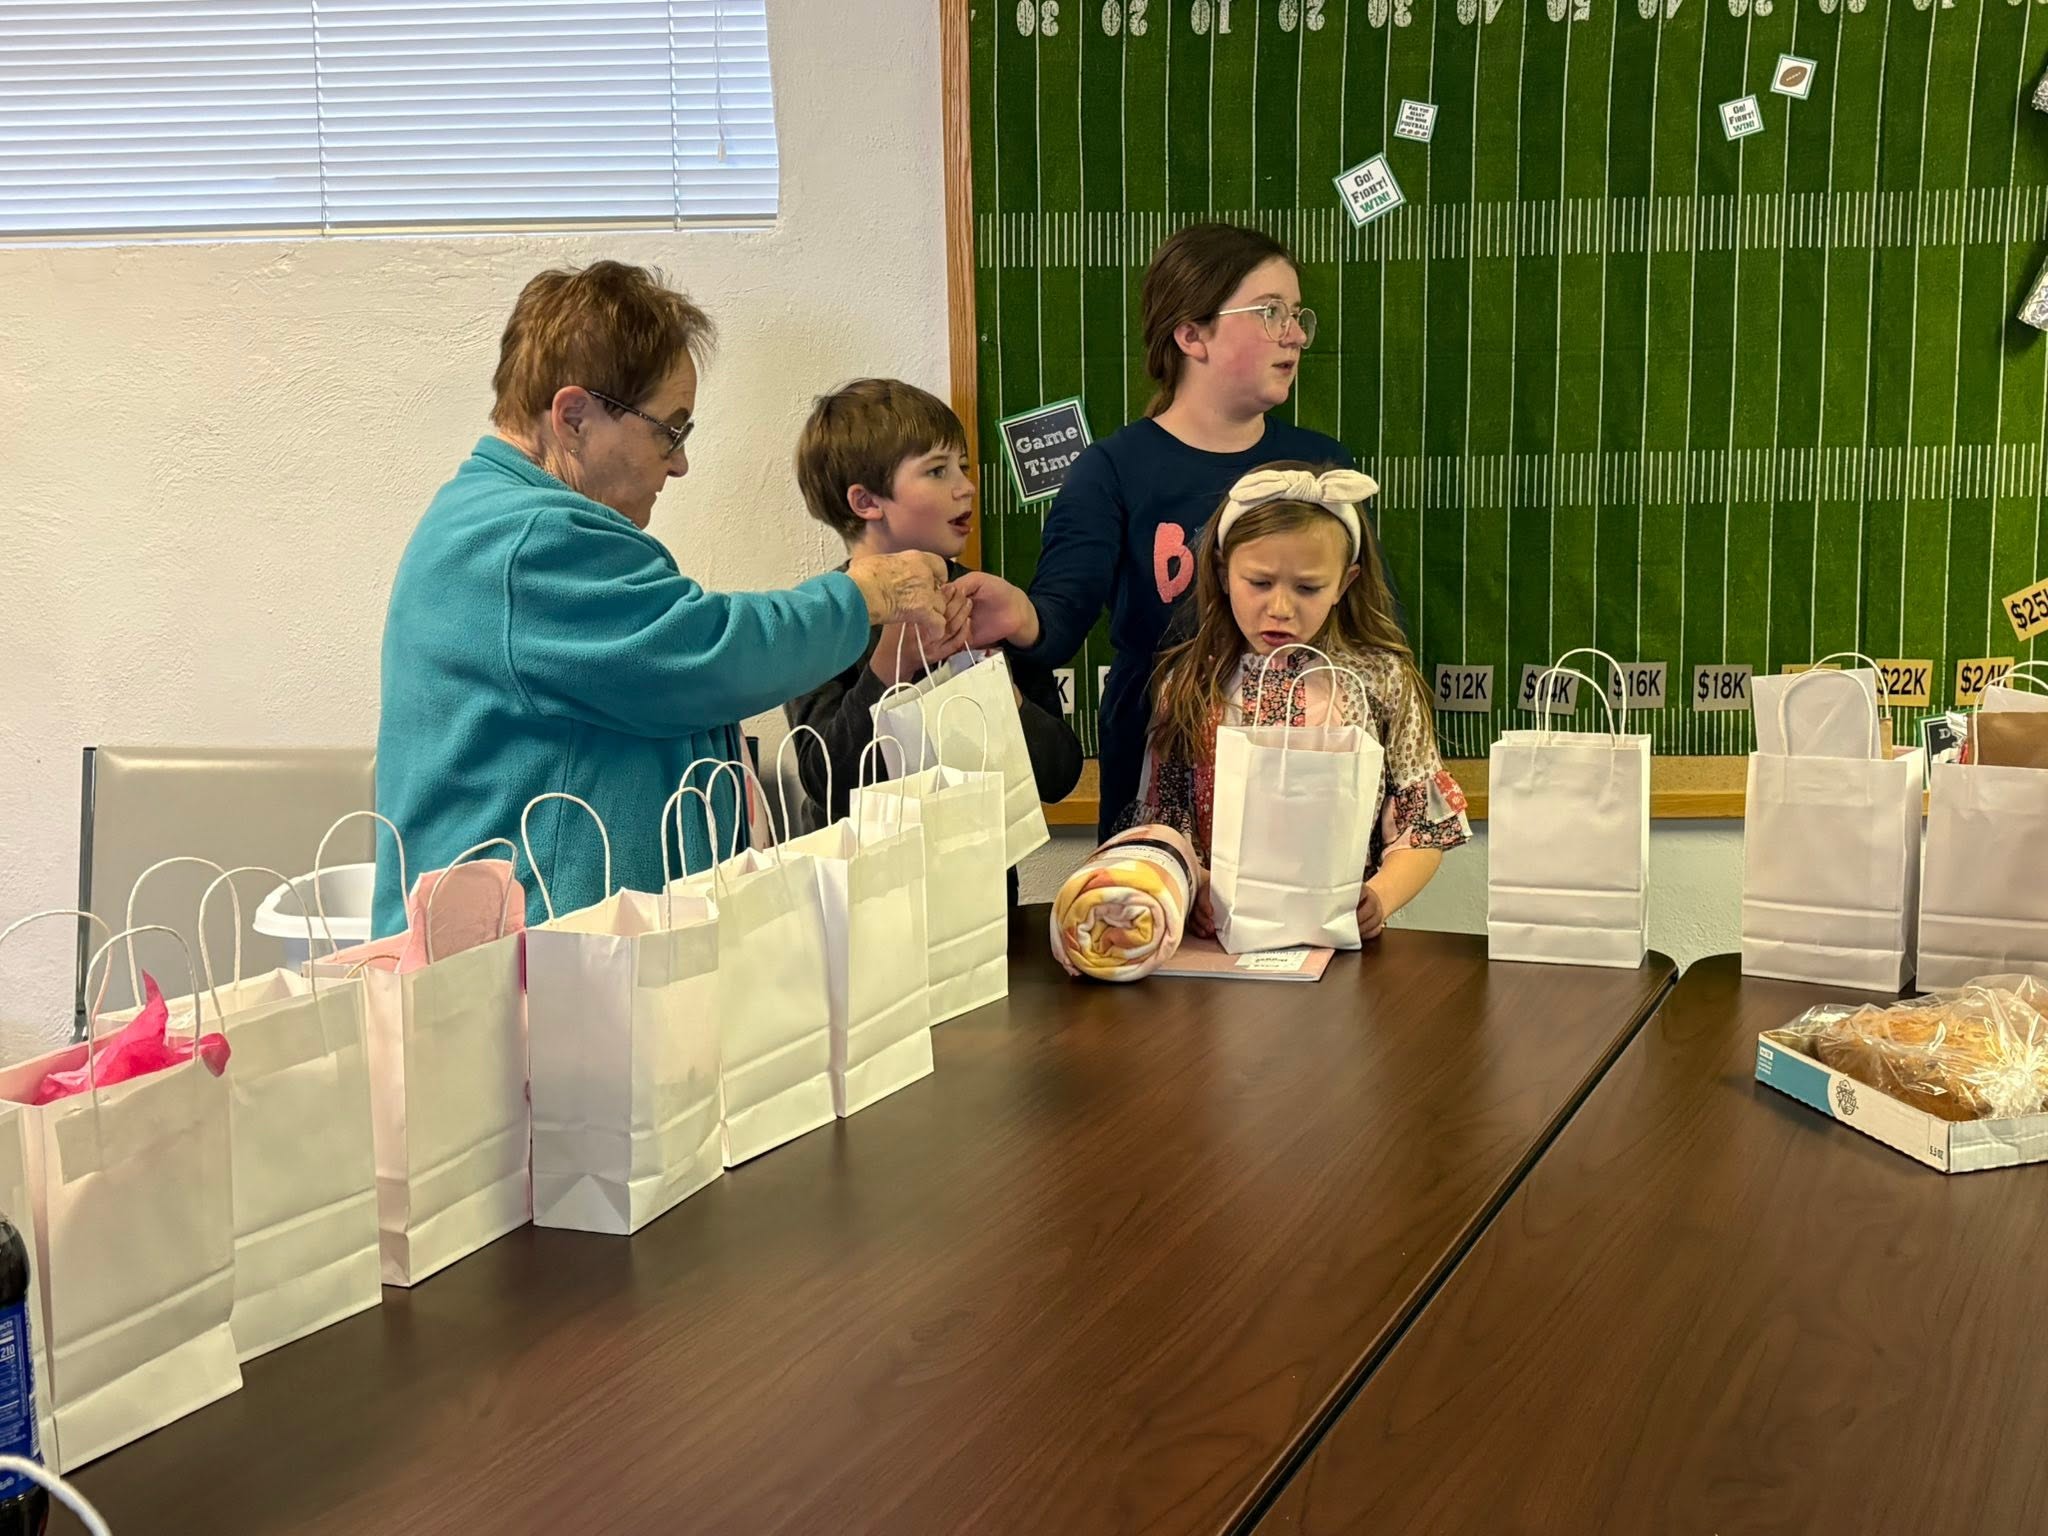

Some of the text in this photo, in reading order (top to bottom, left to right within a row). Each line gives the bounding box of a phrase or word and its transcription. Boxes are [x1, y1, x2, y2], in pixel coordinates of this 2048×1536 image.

[1360, 191, 1391, 213] WIN!
[1015, 426, 1078, 453] Game
[1440, 670, 1487, 702] $12K
[1613, 669, 1661, 700] $16K
[1698, 669, 1747, 702] $18K
